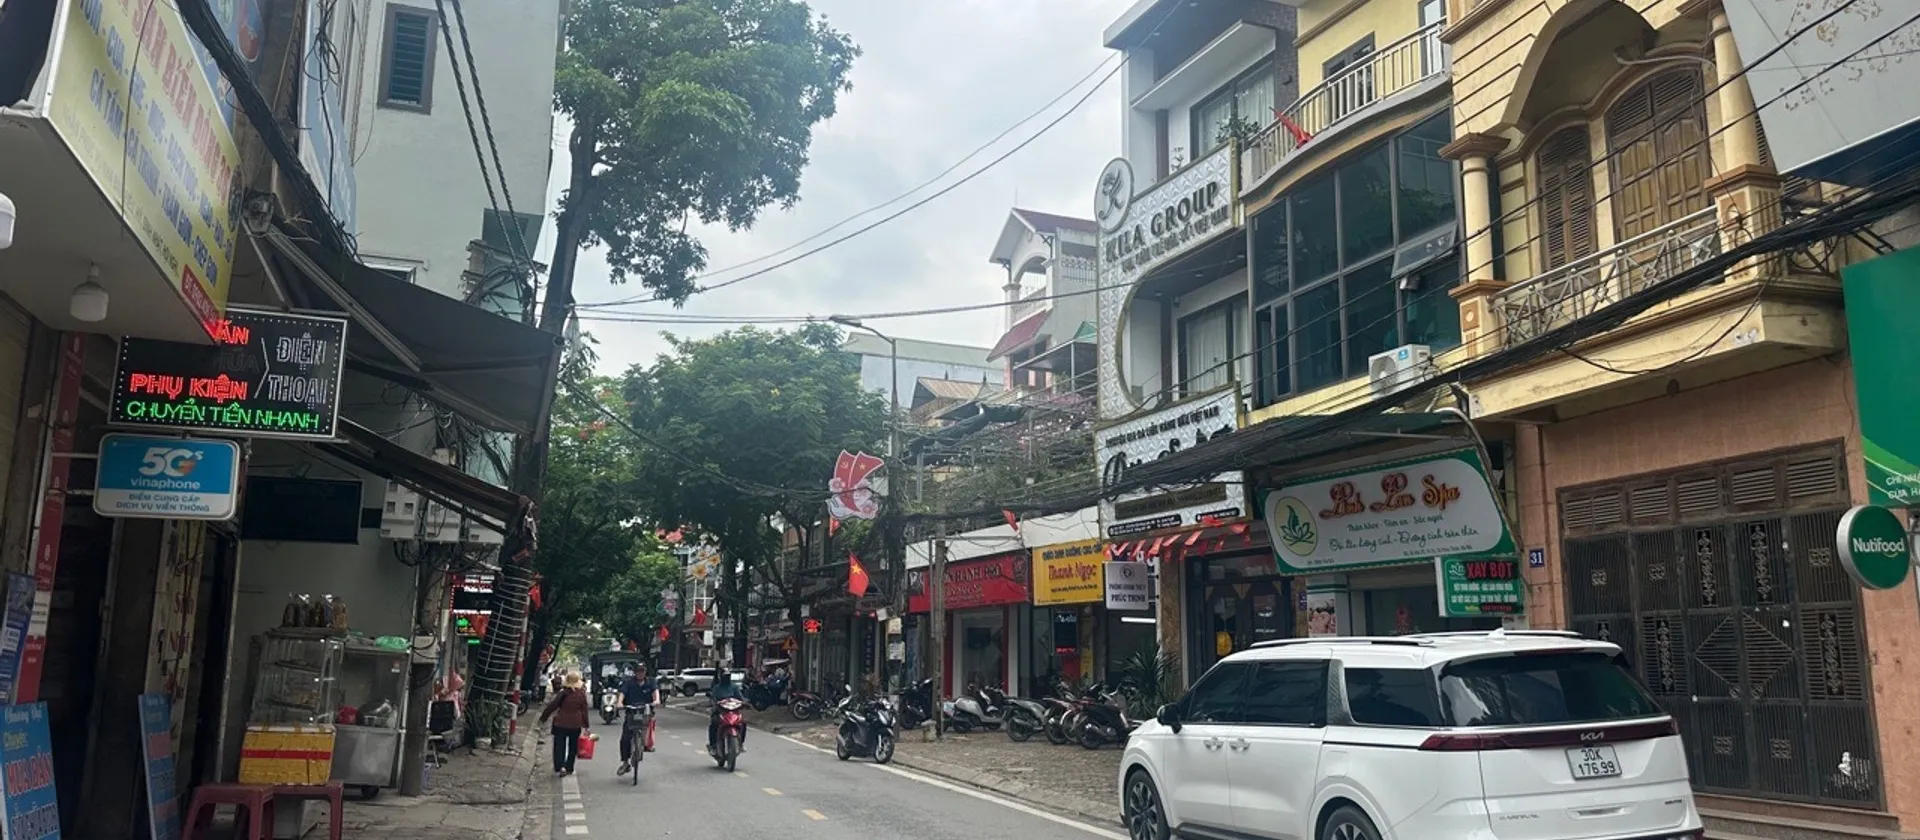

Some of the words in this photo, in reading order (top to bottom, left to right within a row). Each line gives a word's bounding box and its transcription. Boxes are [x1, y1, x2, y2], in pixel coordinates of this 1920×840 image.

[90, 68, 105, 112] CÁ
[1106, 224, 1146, 262] KILA
[1151, 181, 1218, 237] GROUP
[276, 332, 327, 373] ĐIỆN
[129, 373, 184, 400] PHỤ
[189, 373, 249, 404] KIỆN
[268, 374, 328, 409] THOẠI
[126, 397, 206, 421] CHUYỂN
[209, 402, 252, 424] TIỀN
[255, 409, 319, 428] NHANH
[1203, 405, 1220, 419] NAM
[130, 477, 201, 490] vinaphone
[1420, 473, 1461, 511] Spa
[129, 492, 151, 501] ĐIỂM
[153, 494, 180, 502] CUNG
[181, 493, 201, 502] CẤP
[116, 502, 139, 510] DỊCH
[155, 503, 177, 511] VIỄN
[179, 503, 210, 512] THÔNG
[1852, 537, 1906, 553] Nutifood
[1531, 552, 1543, 565] 31
[1048, 564, 1074, 581] Thanh
[1467, 562, 1487, 580] XAY
[1581, 749, 1603, 761] 30K
[1578, 760, 1616, 776] 176.99
